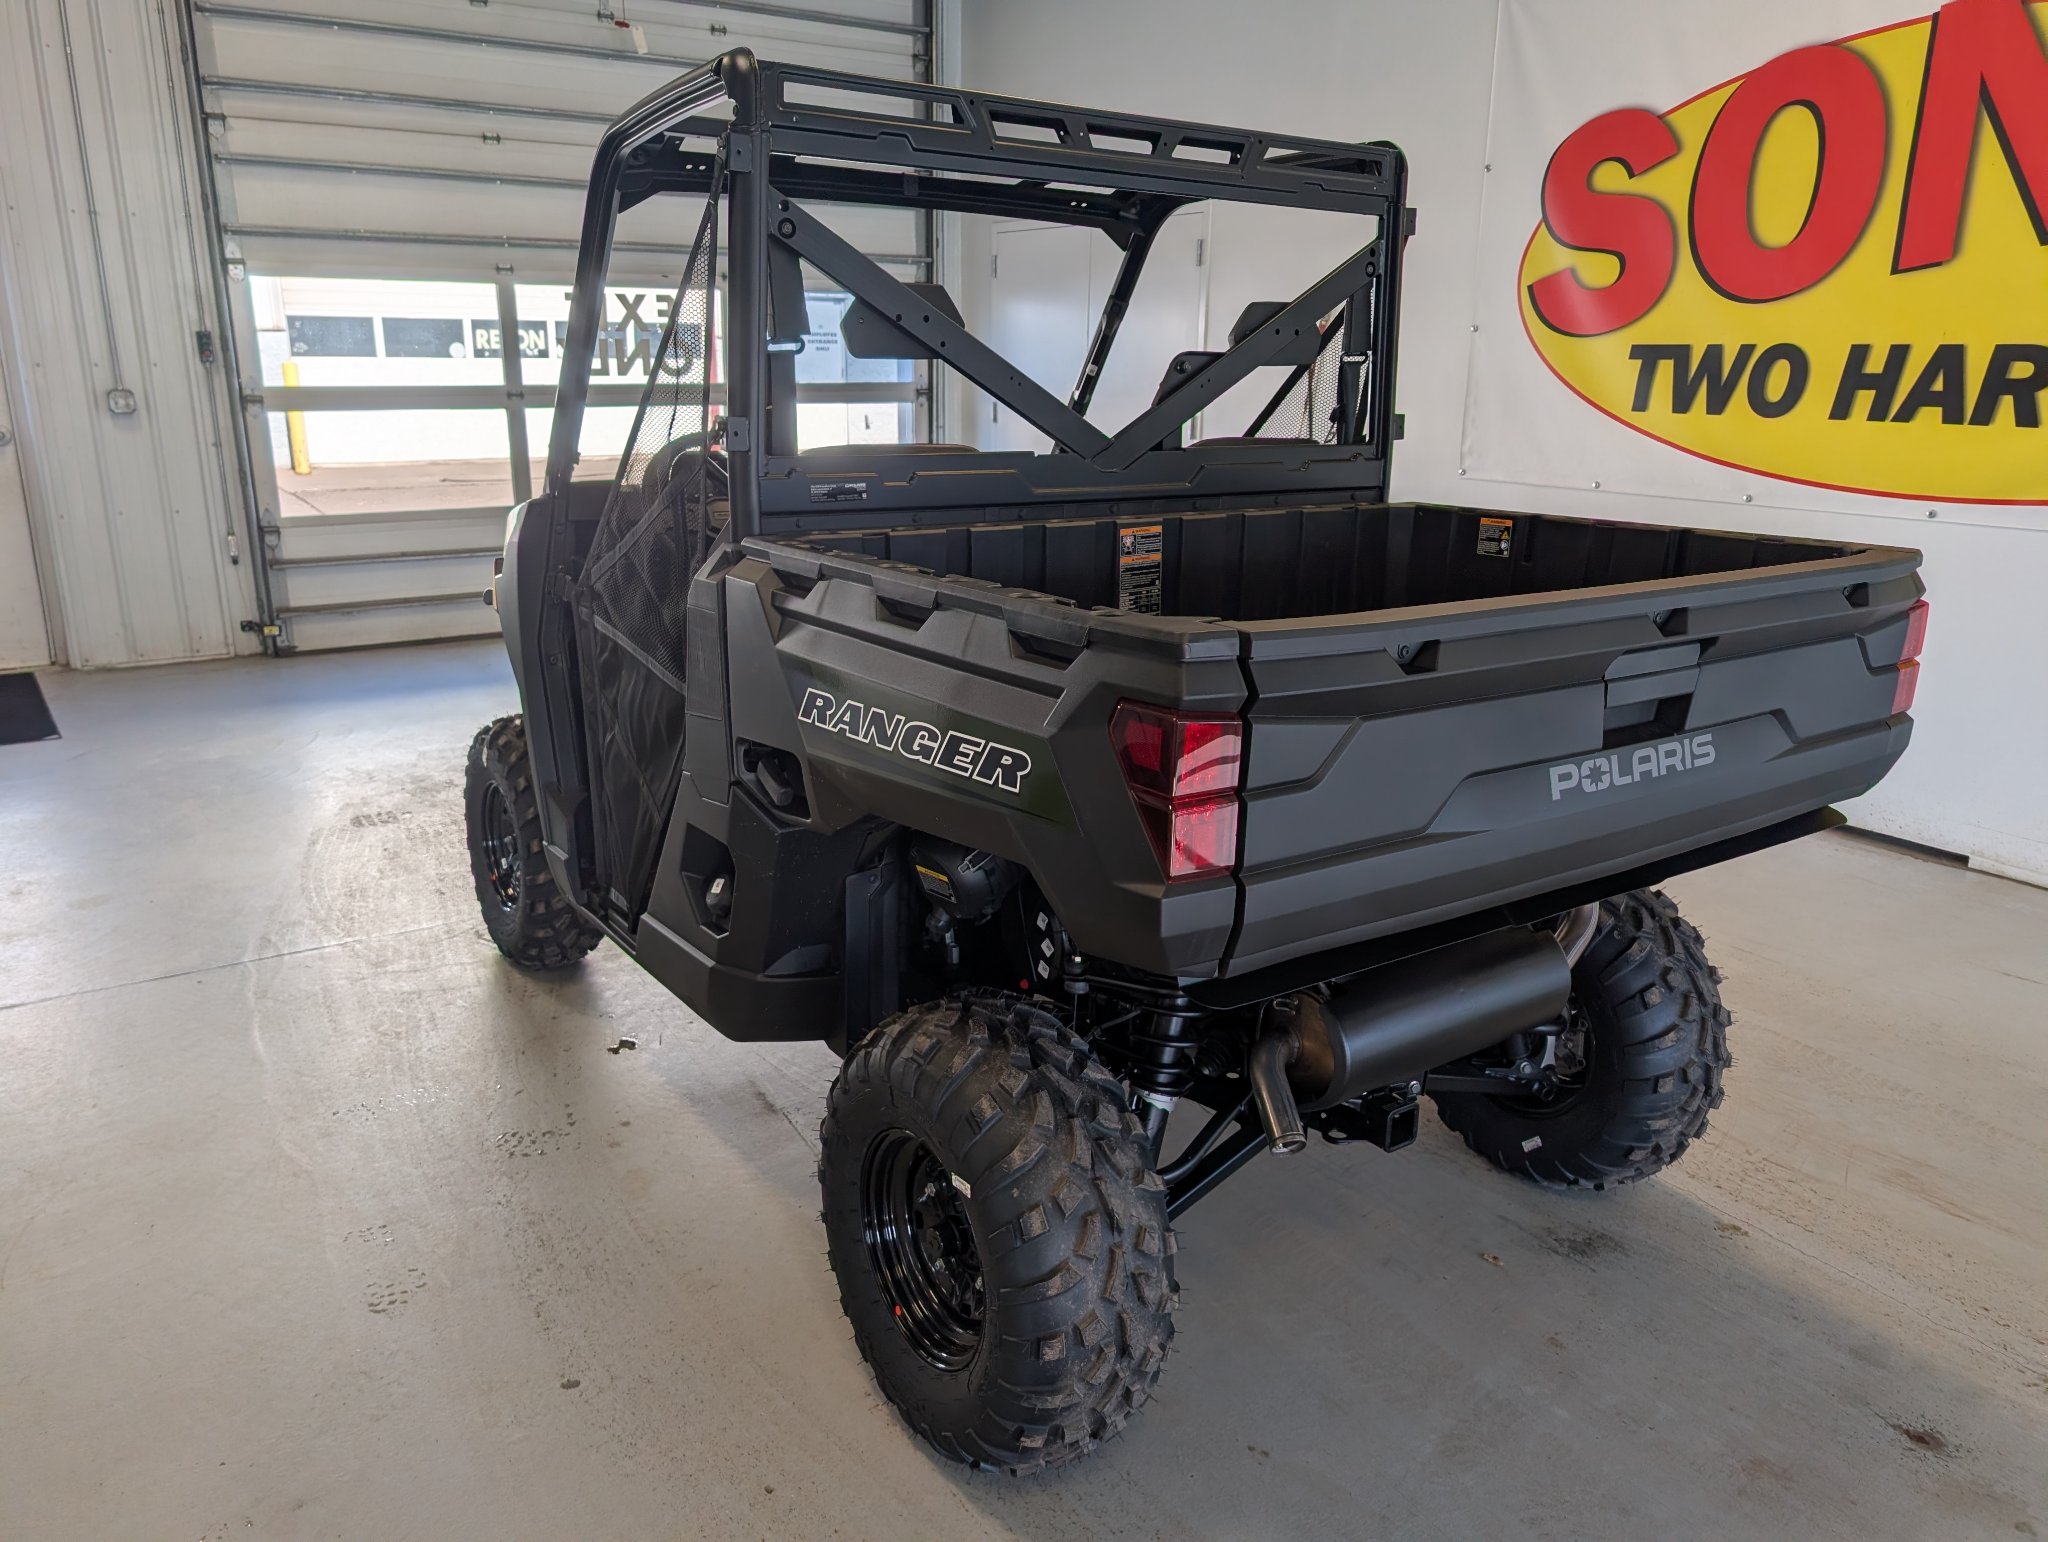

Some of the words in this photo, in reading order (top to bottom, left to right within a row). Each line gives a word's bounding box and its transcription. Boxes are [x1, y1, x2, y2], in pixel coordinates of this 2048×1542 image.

[475, 328, 546, 351] REON
[1627, 343, 1810, 418] TWO
[1828, 344, 2048, 428] HAR
[797, 687, 1032, 794] RANGER
[1549, 733, 1716, 801] POLARIS
